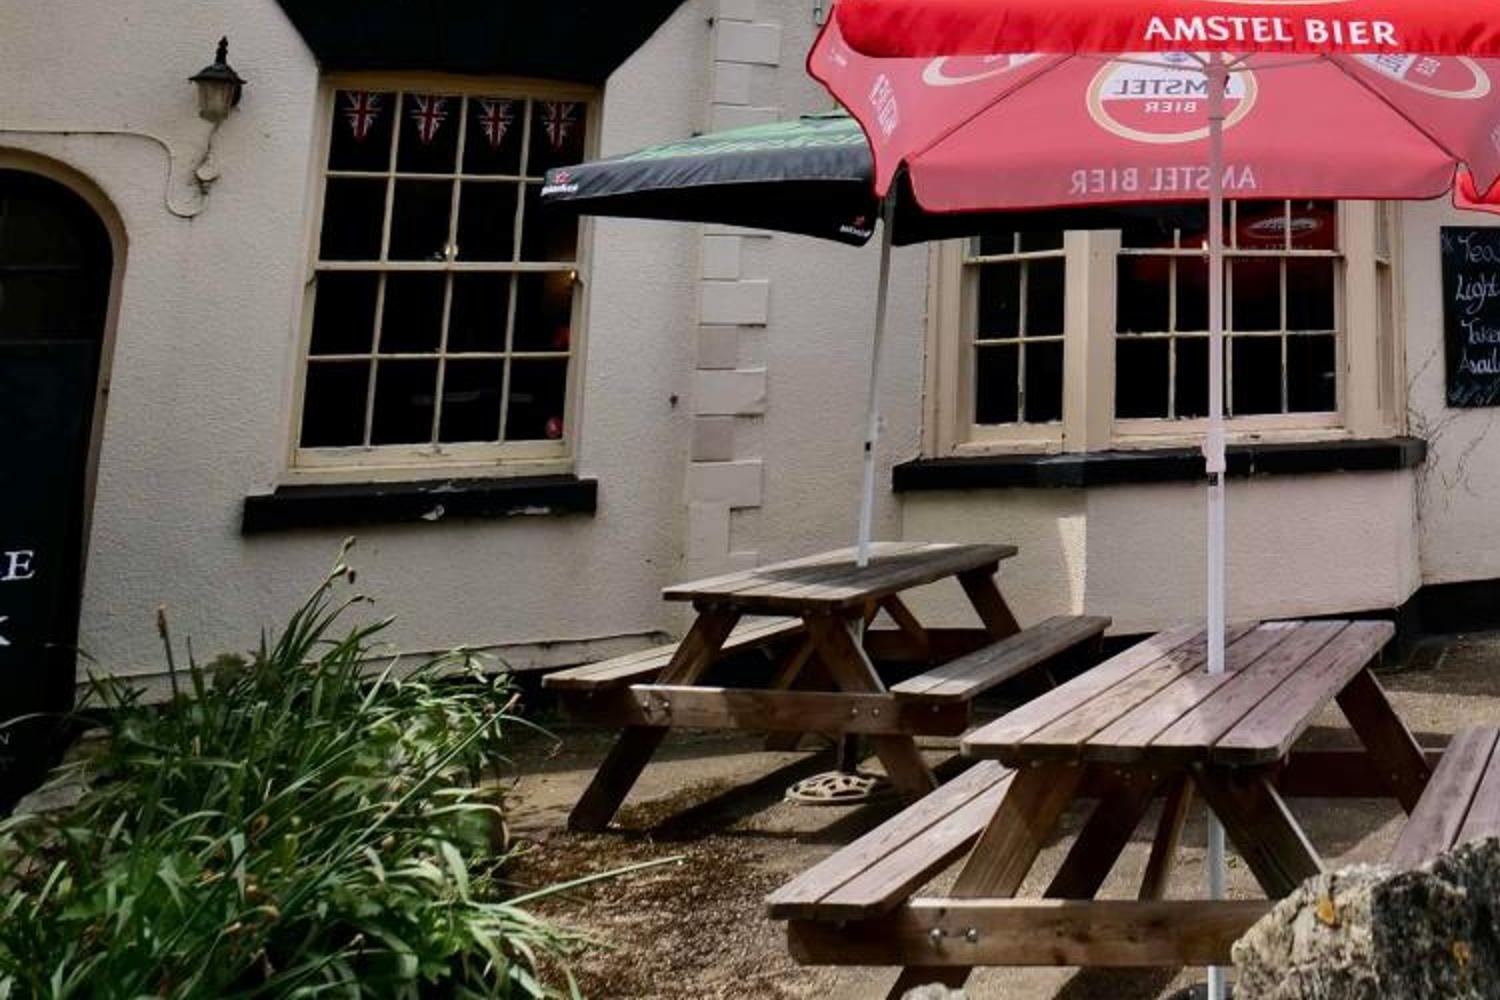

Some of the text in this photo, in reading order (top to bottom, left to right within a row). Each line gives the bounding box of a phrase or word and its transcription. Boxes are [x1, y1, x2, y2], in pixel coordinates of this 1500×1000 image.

[1143, 16, 1398, 46] AMSTEL BIER
[1455, 272, 1500, 314] Light
